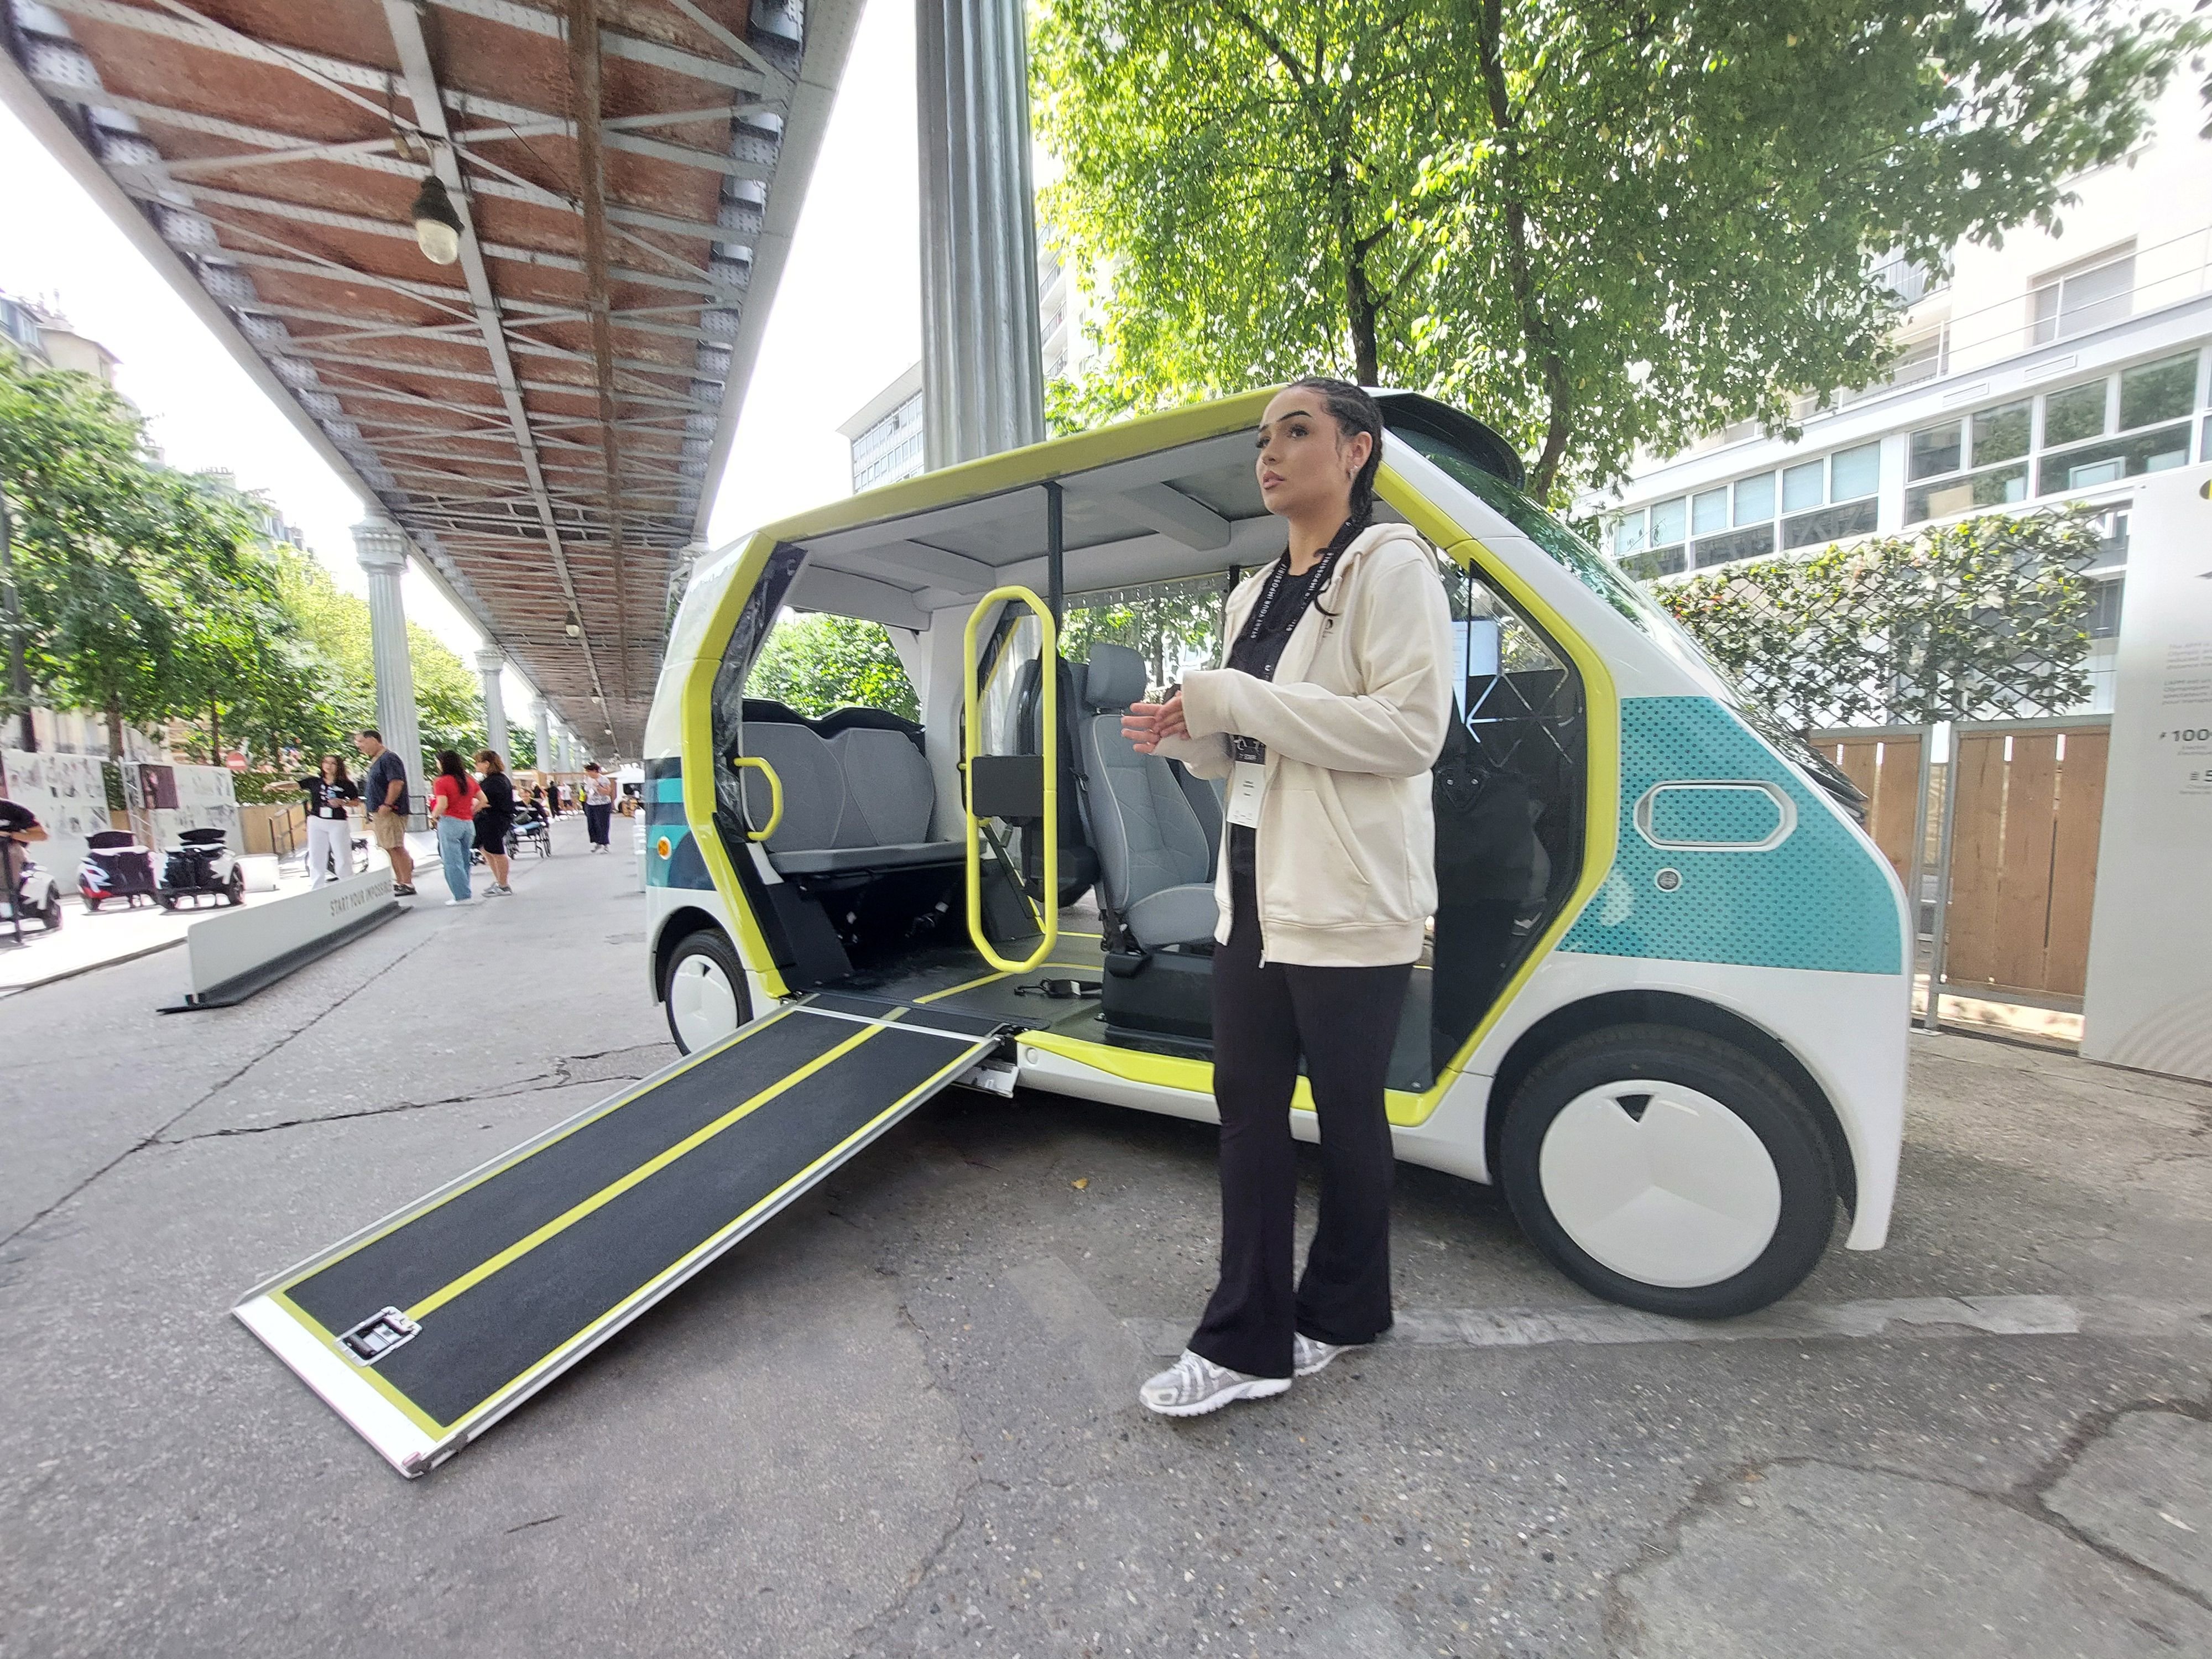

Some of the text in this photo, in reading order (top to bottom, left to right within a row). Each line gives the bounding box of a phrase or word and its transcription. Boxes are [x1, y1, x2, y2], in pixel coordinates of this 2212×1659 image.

[1250, 619, 1264, 639] START
[1258, 601, 1271, 618] YOUR
[2171, 729, 2212, 742] 100
[330, 895, 349, 916] START
